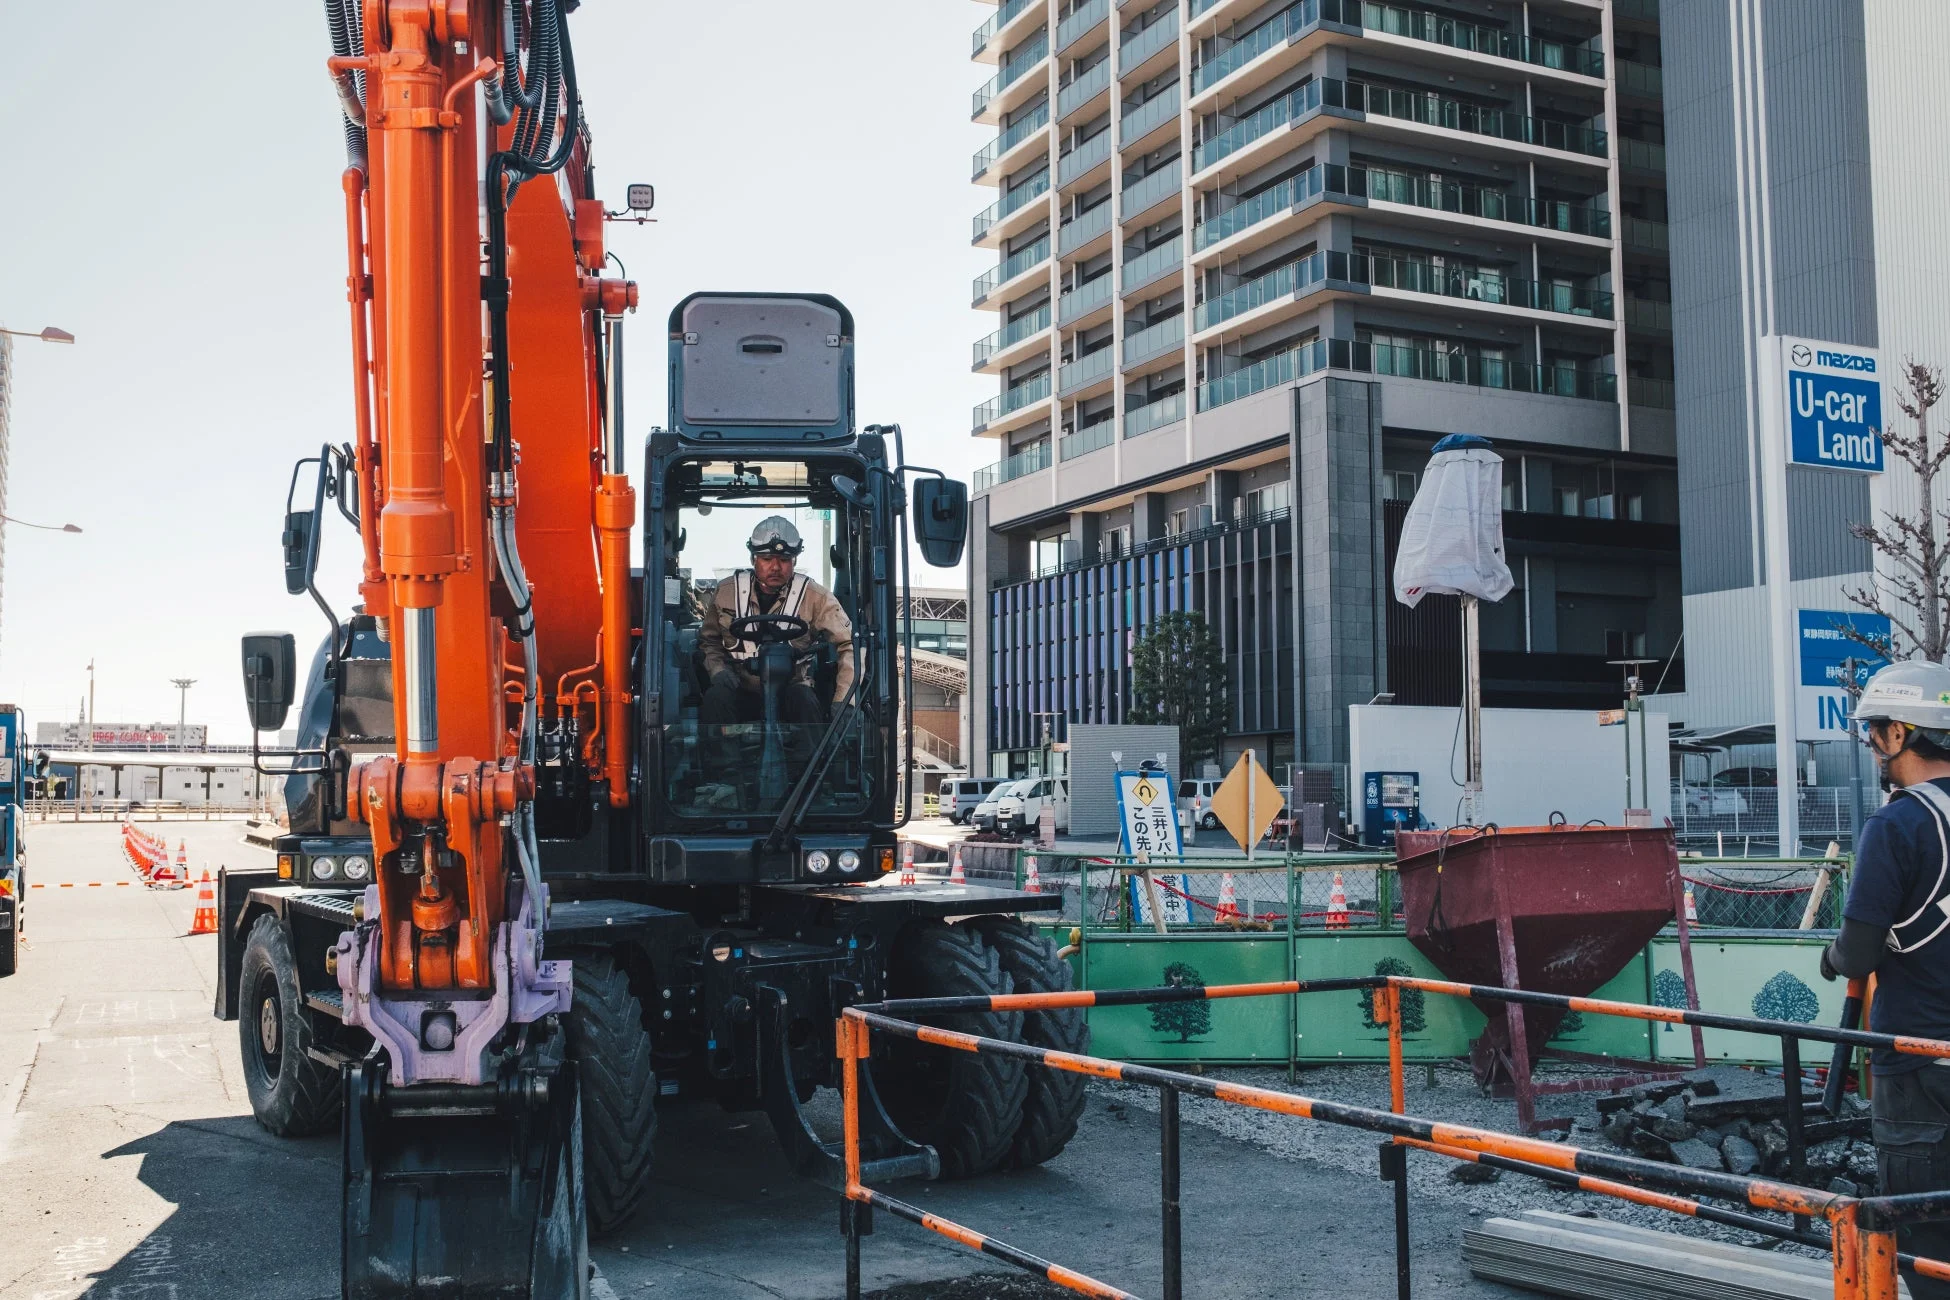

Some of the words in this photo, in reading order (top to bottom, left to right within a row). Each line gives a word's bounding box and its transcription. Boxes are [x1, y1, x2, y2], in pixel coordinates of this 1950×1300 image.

[1795, 378, 1867, 424] U-car
[1817, 420, 1876, 464] Land
[1818, 696, 1849, 730] IN
